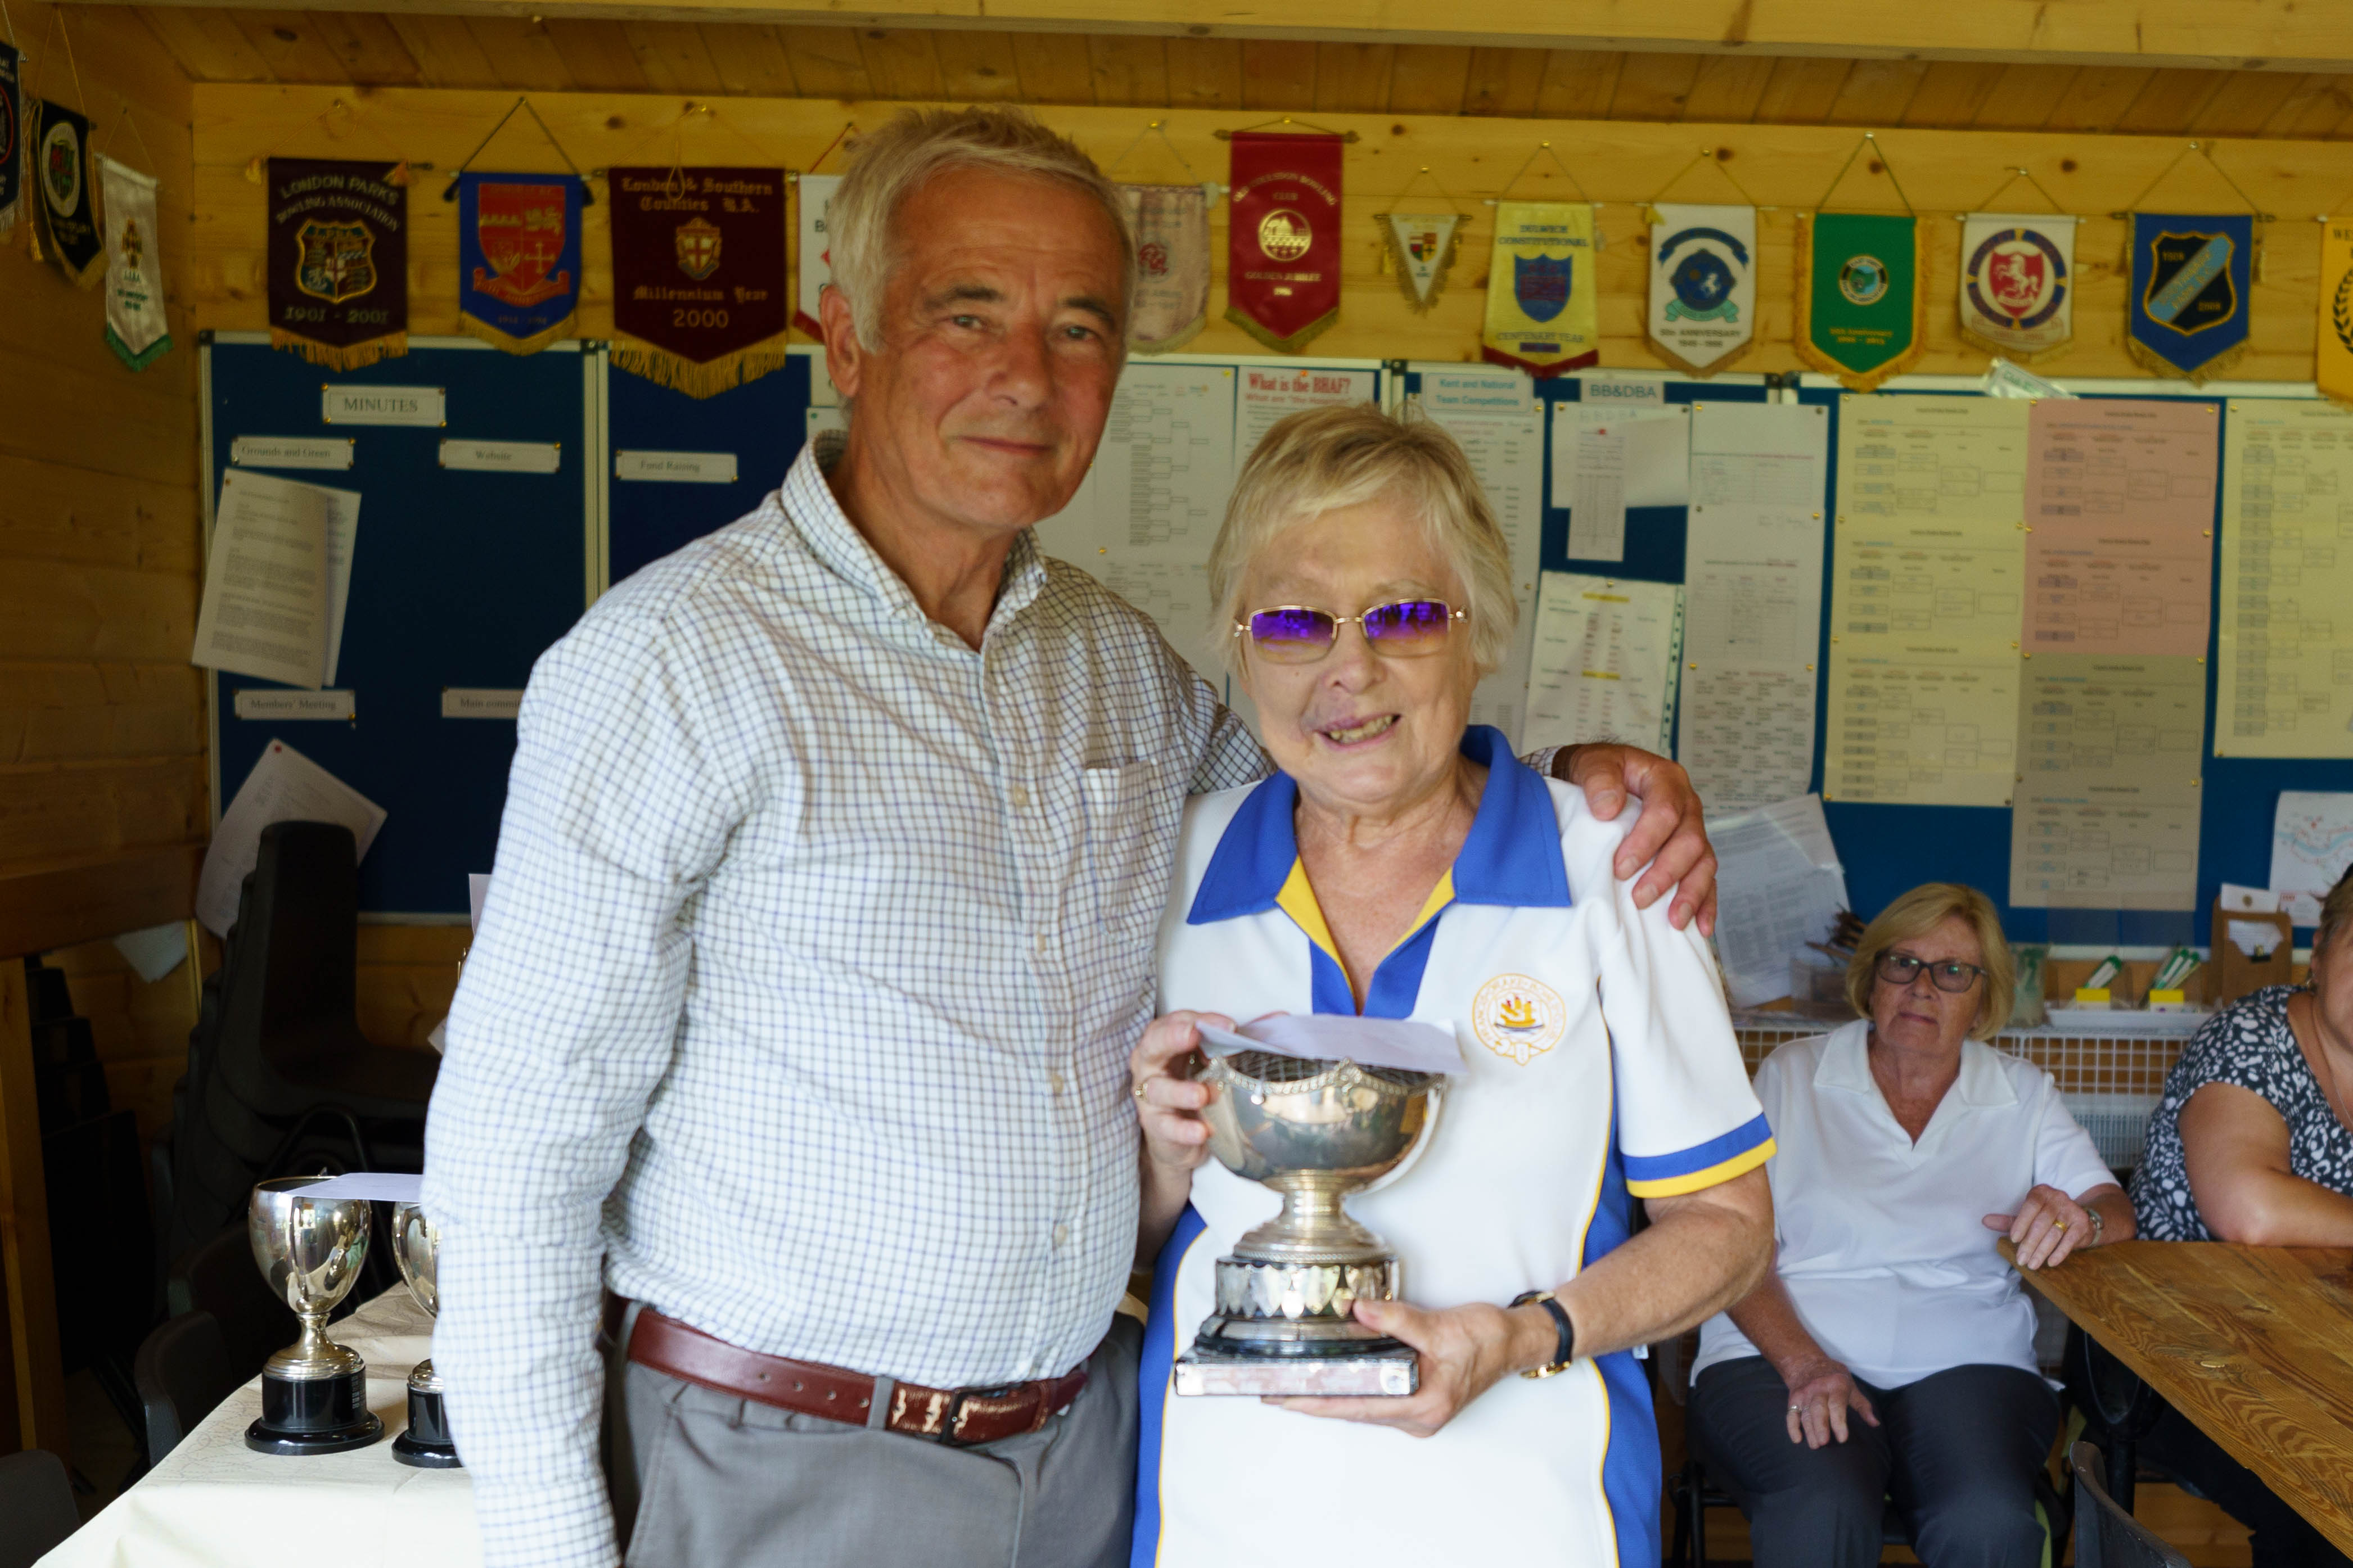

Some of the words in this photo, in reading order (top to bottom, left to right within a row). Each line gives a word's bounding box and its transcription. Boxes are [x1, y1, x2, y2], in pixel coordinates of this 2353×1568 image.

[279, 174, 344, 198] LONDON
[347, 176, 400, 206] PARKS
[621, 177, 679, 192] London
[686, 177, 698, 192] &
[701, 177, 773, 196] Southern
[639, 196, 710, 211] Counties
[276, 195, 326, 225] BOWLING
[328, 196, 401, 232] ASSOCIATION
[1498, 237, 1589, 247] CONSTITUTIONAL
[633, 285, 724, 301] Millennium
[733, 286, 769, 304] Year
[284, 305, 327, 322] 1901
[346, 309, 390, 324] 2001
[673, 308, 729, 328] 2000
[1497, 332, 1556, 341] CENTENARY
[1559, 333, 1584, 342] YEAR
[1248, 372, 1277, 391] What
[1279, 375, 1290, 392] is
[1292, 374, 1309, 392] the
[1439, 379, 1460, 387] Kent
[1462, 379, 1478, 388] and
[1481, 379, 1516, 389] National
[1590, 384, 1657, 399] BB&DBA
[344, 397, 418, 413] MINUTES
[1436, 395, 1459, 404] Team
[1462, 396, 1520, 405] Competitions
[241, 446, 281, 457] Grounds
[284, 448, 300, 457] and
[303, 449, 331, 458] Green
[475, 450, 512, 460] Website
[641, 460, 664, 471] Fund
[299, 699, 336, 711] Meeting
[460, 697, 484, 708] Main
